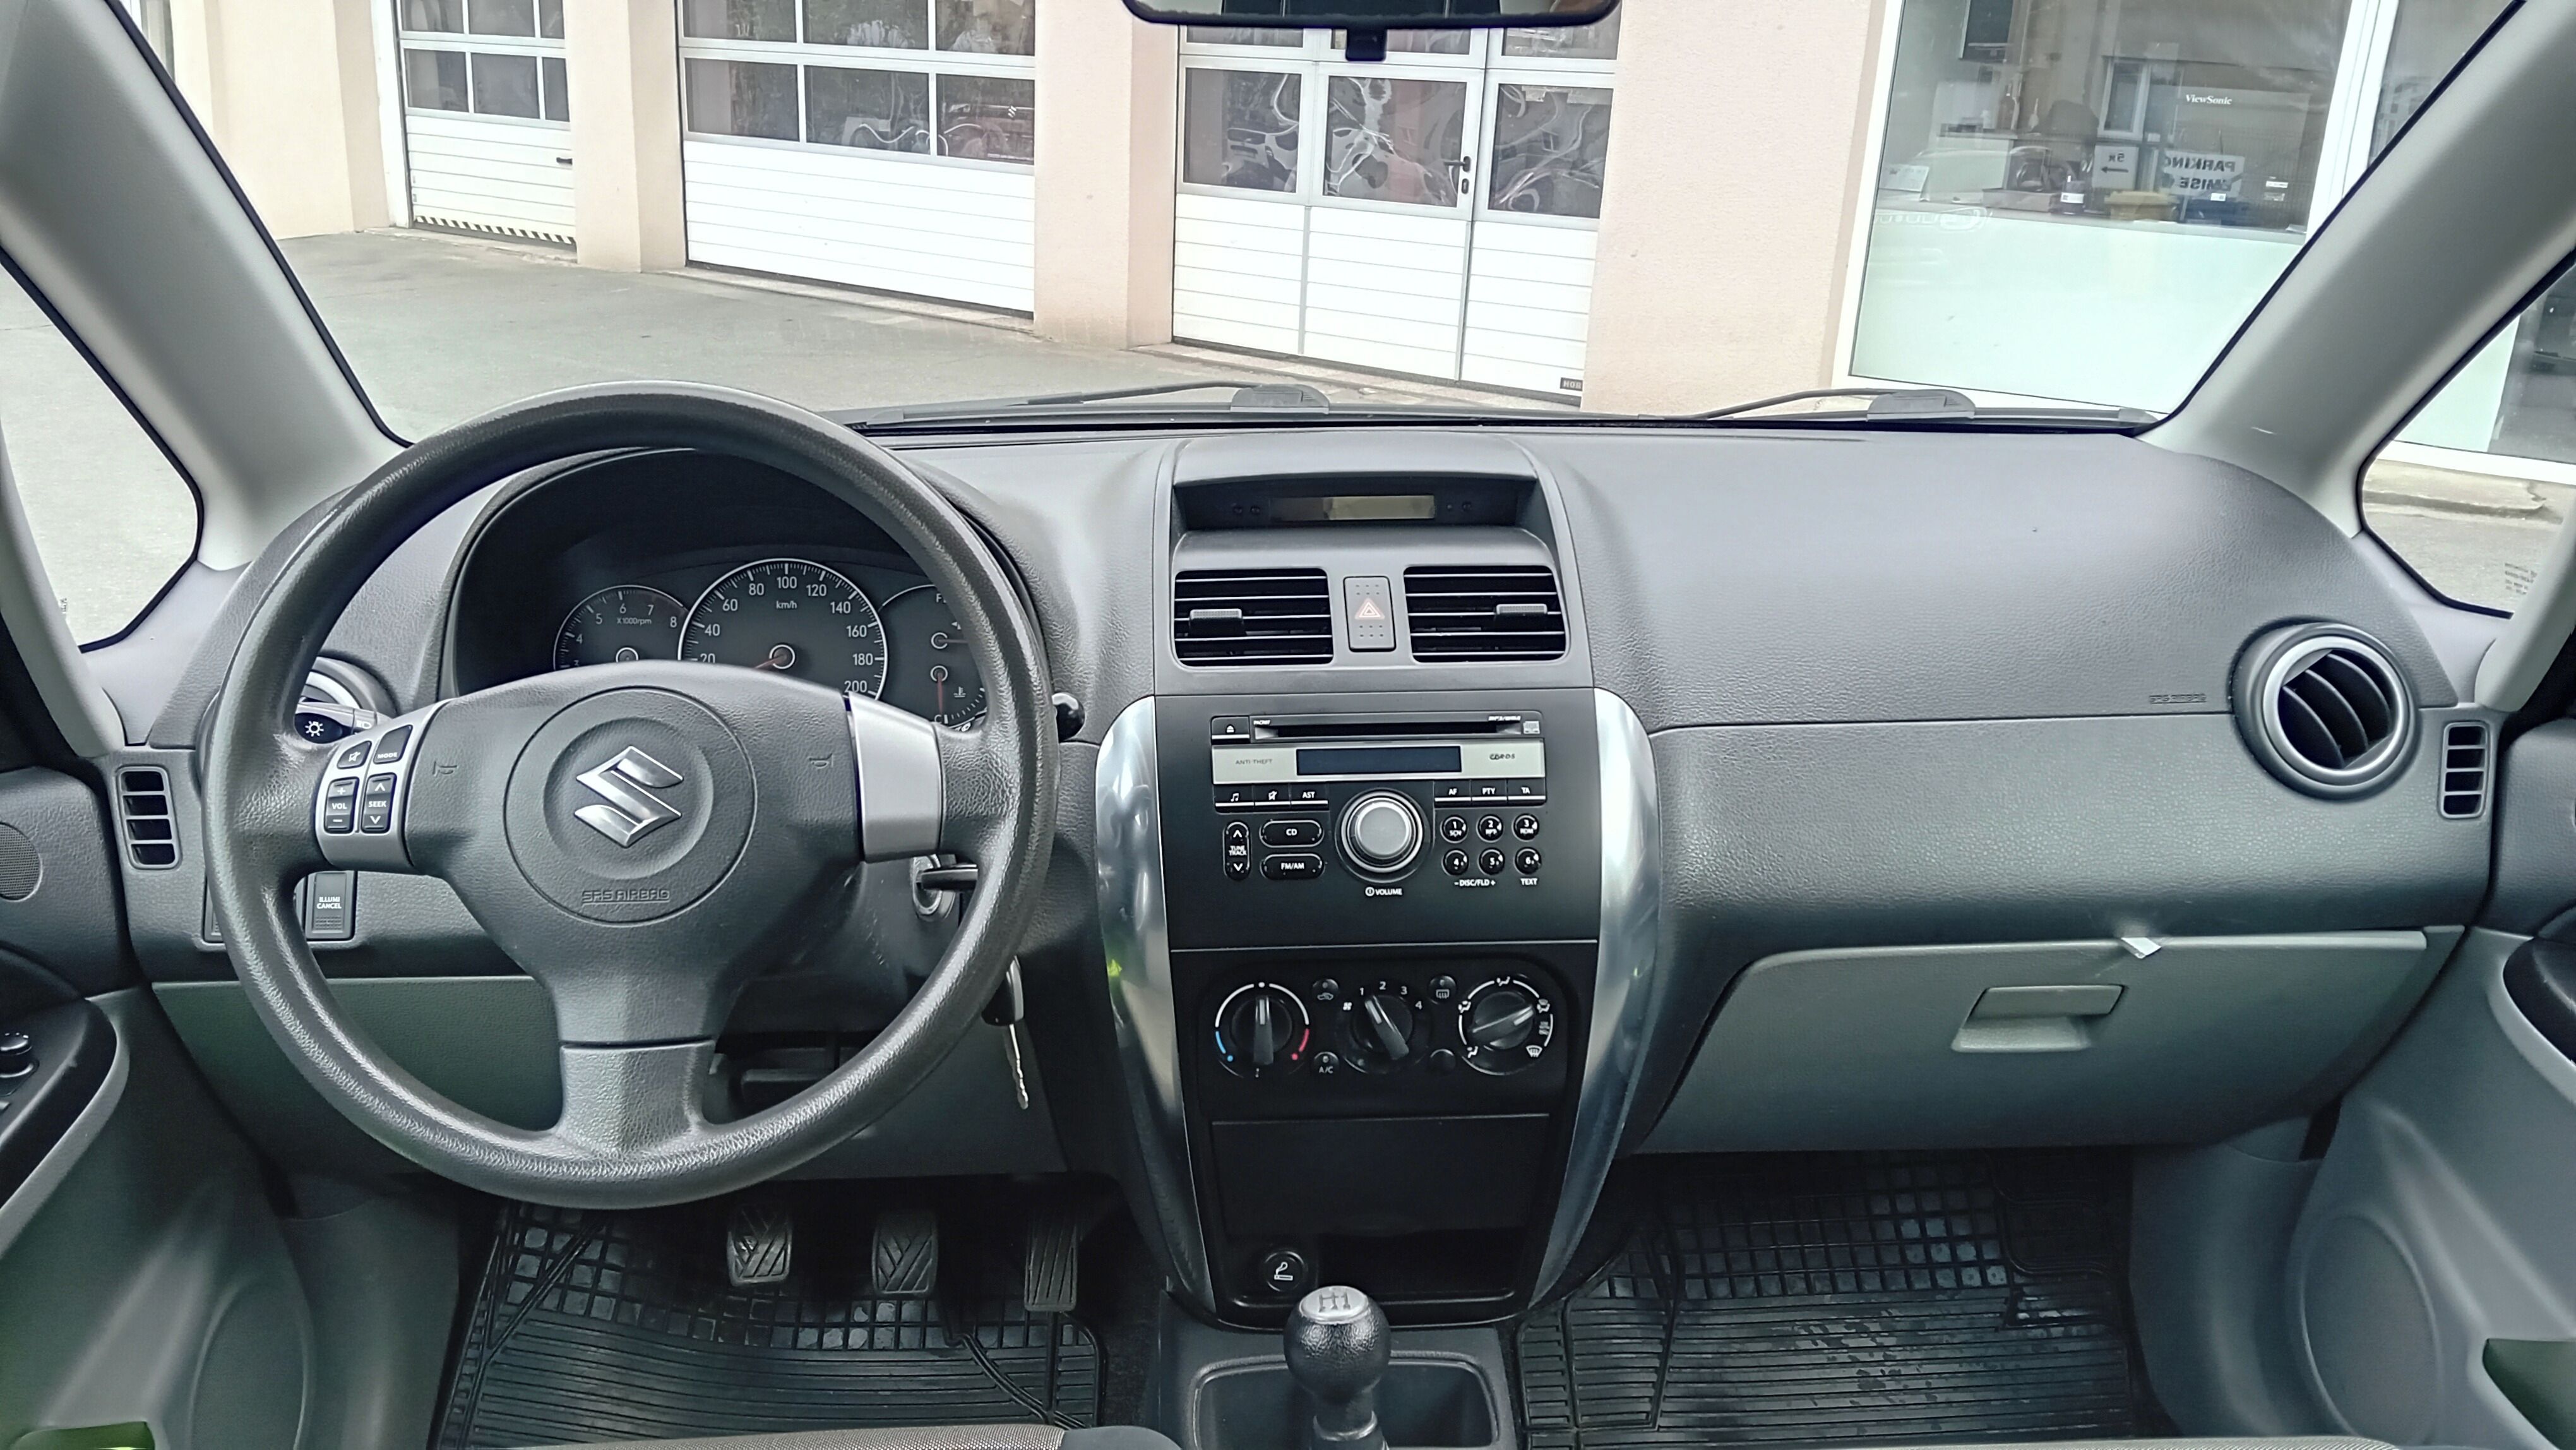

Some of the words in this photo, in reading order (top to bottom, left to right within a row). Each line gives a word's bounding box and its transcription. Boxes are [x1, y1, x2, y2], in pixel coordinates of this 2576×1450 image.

[2185, 94, 2233, 105] ViewSonic
[777, 576, 797, 589] 100
[749, 583, 765, 596] 80
[806, 584, 827, 597] 120
[619, 603, 626, 614] 6
[648, 604, 654, 616] 7
[722, 599, 738, 611] 60
[776, 601, 797, 609] km/h
[830, 601, 851, 614] 140
[595, 613, 602, 625] 5
[670, 616, 677, 628] 8
[705, 623, 720, 636] 40
[846, 625, 868, 638] 160
[576, 633, 583, 644] 4
[700, 653, 716, 663] 20
[852, 653, 873, 666] 180
[844, 680, 868, 693] 200
[1452, 821, 1457, 829] 1
[1524, 819, 1529, 827] 3
[1489, 858, 1495, 866] 5
[582, 890, 613, 902] SRS
[616, 889, 670, 901] AIRBAG
[1359, 987, 1364, 996] 1
[1379, 981, 1386, 990] 2
[1400, 986, 1408, 995] 3
[1415, 1001, 1422, 1010] 4
